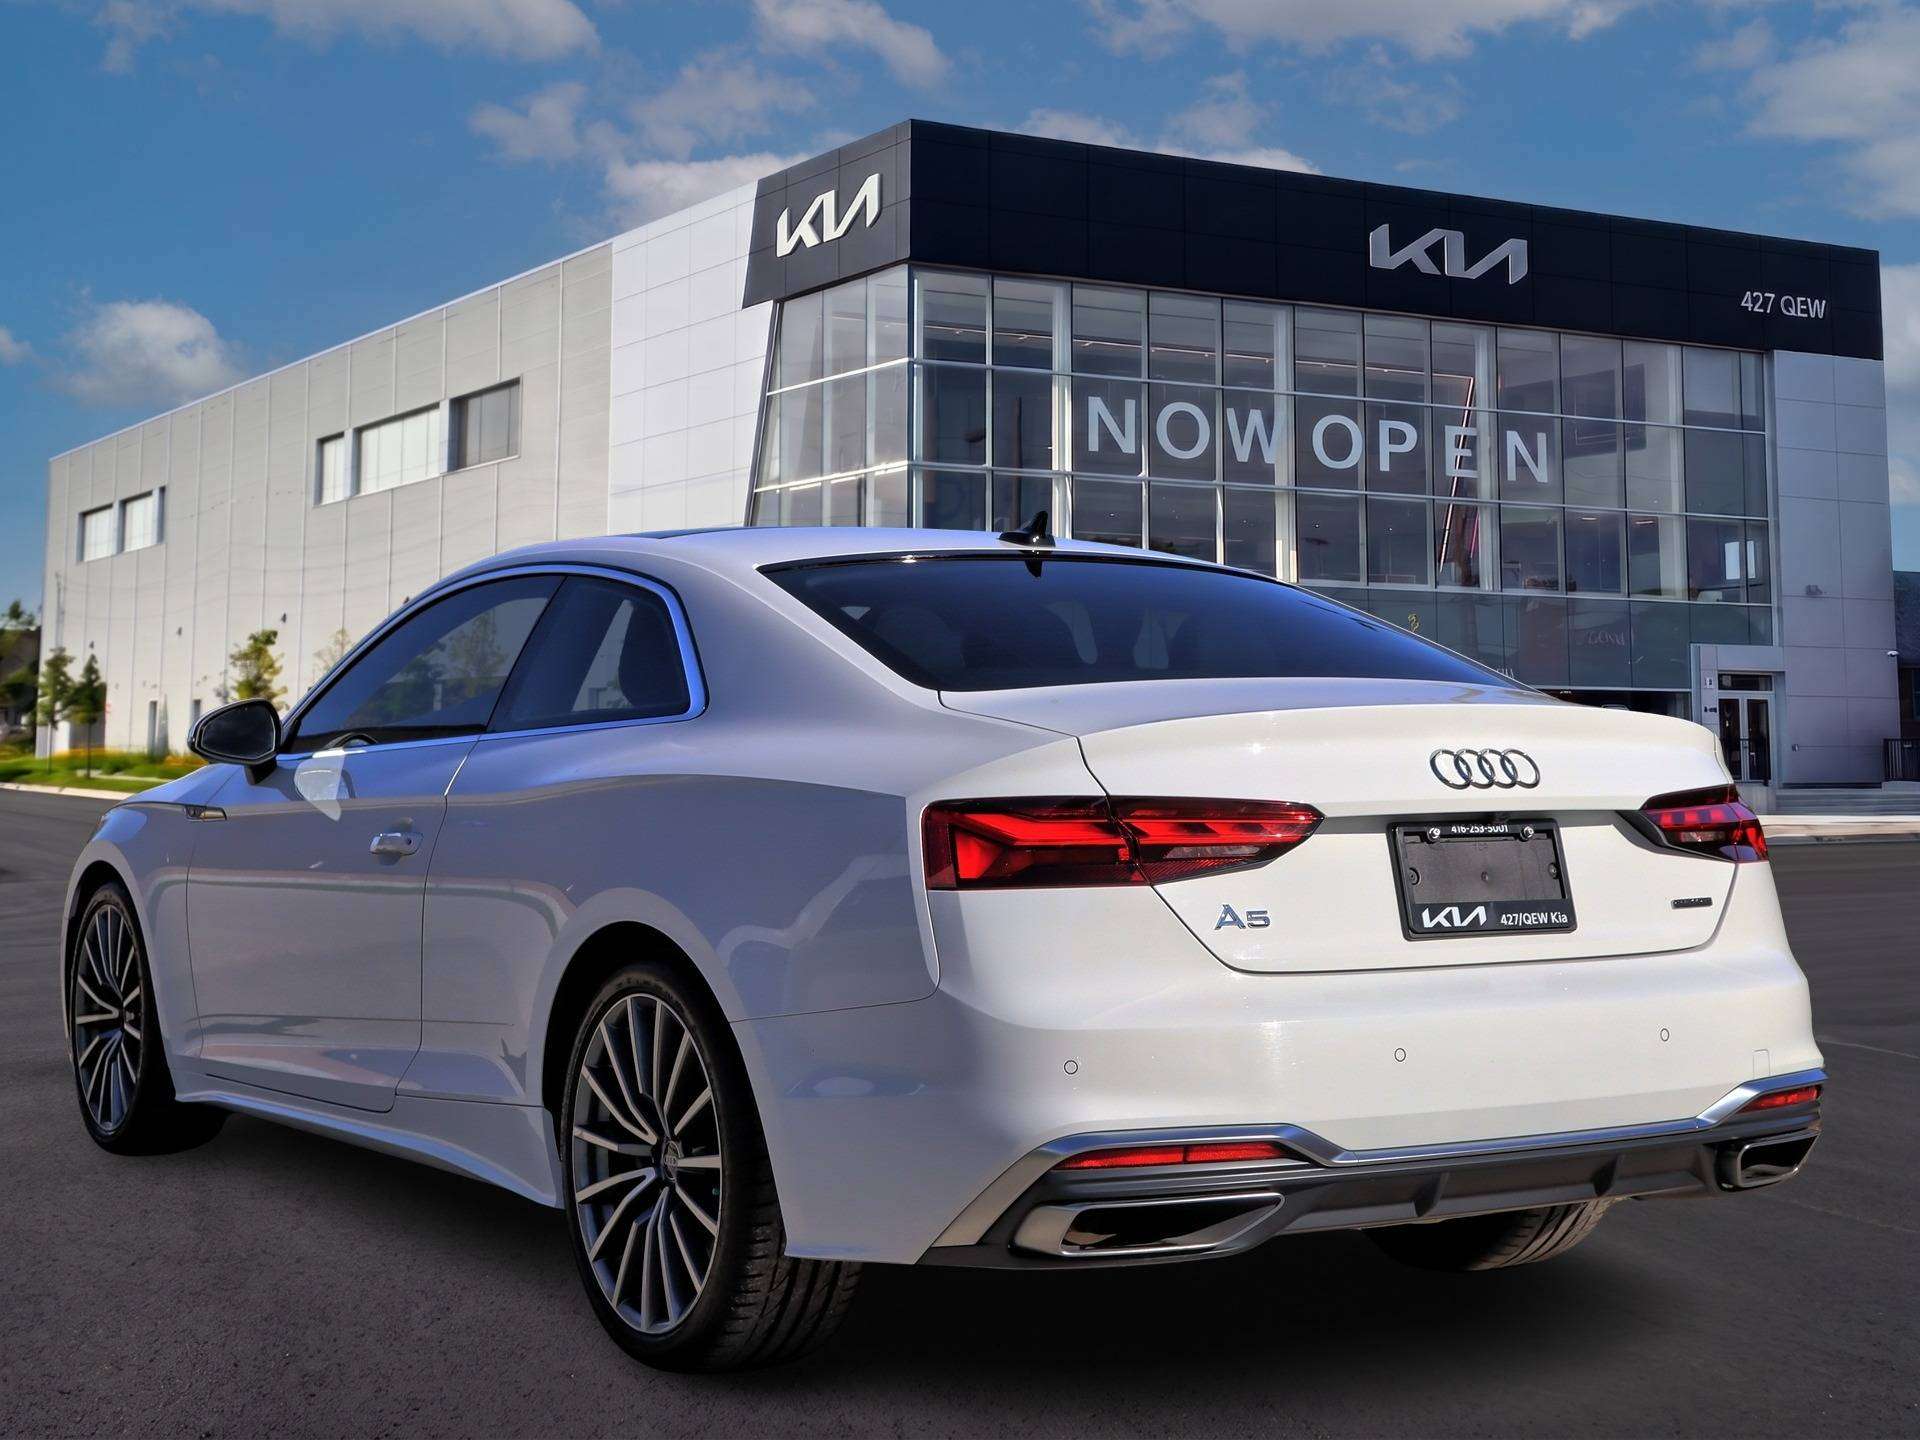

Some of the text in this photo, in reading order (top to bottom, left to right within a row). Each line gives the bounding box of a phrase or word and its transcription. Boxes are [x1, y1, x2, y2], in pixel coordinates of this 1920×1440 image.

[777, 173, 880, 258] KIA
[1369, 223, 1528, 285] KIA
[1740, 291, 1826, 319] 427 QEW
[1087, 396, 1549, 484] NOW OPEN
[1214, 903, 1271, 931] A5
[1422, 905, 1487, 928] KIA
[1500, 911, 1568, 927] 427/QEW Kia
